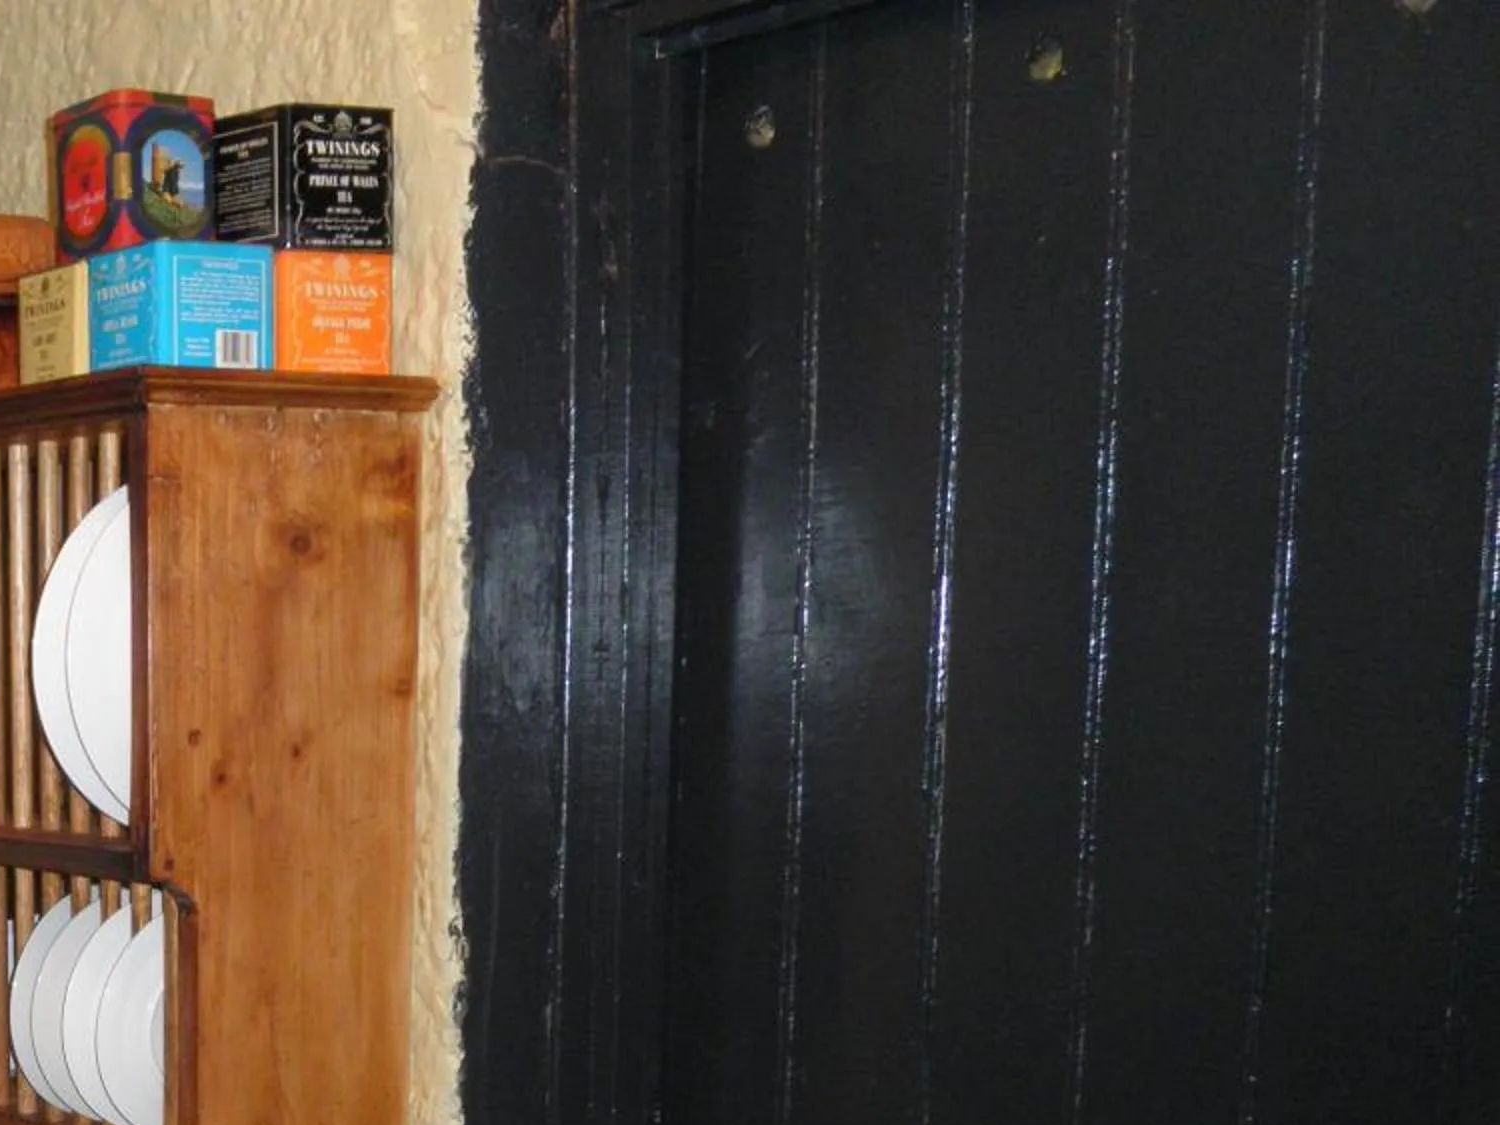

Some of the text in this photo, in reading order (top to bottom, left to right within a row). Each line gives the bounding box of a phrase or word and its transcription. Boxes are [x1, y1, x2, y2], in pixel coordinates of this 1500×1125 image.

[304, 139, 381, 157] TWININGS
[308, 174, 339, 188] PRINCE
[96, 277, 148, 305] TWININGS
[304, 280, 379, 299] TWININGS
[25, 296, 66, 320] TWININGS
